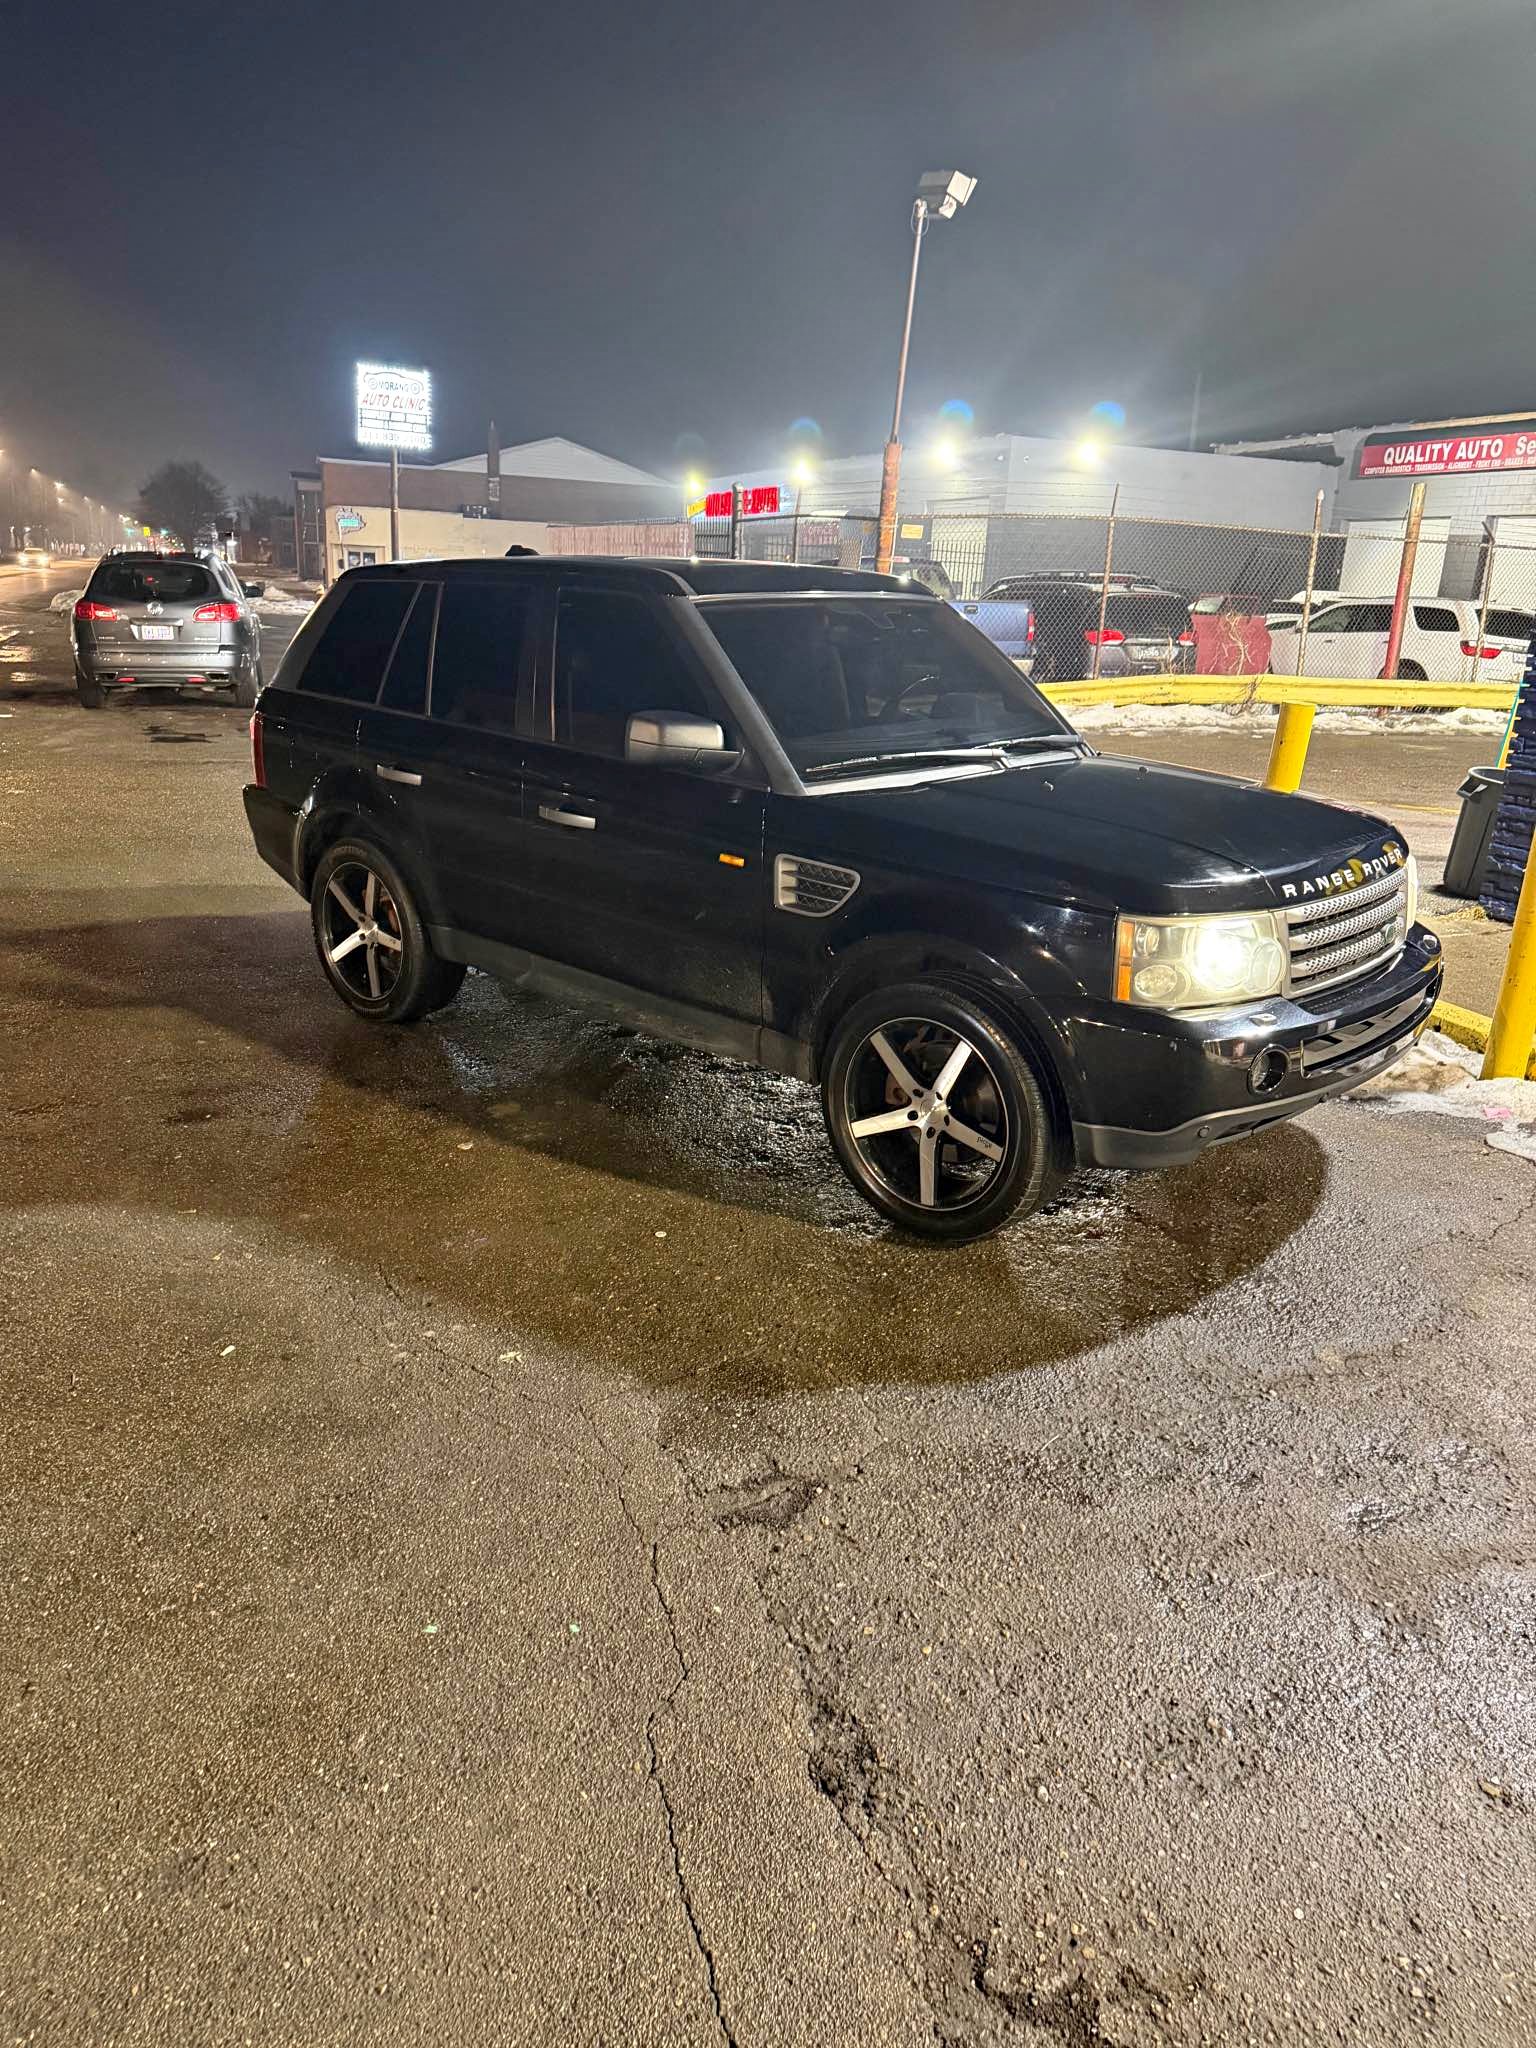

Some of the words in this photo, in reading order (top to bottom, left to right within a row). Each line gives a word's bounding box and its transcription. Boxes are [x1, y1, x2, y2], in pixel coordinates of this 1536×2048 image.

[362, 392, 390, 407] AUTO
[392, 396, 427, 411] CLINIC
[1384, 442, 1453, 465] QUALITY
[1455, 438, 1503, 460] AUTO
[1281, 868, 1355, 899] RANGE
[1361, 848, 1403, 877] ROVER
